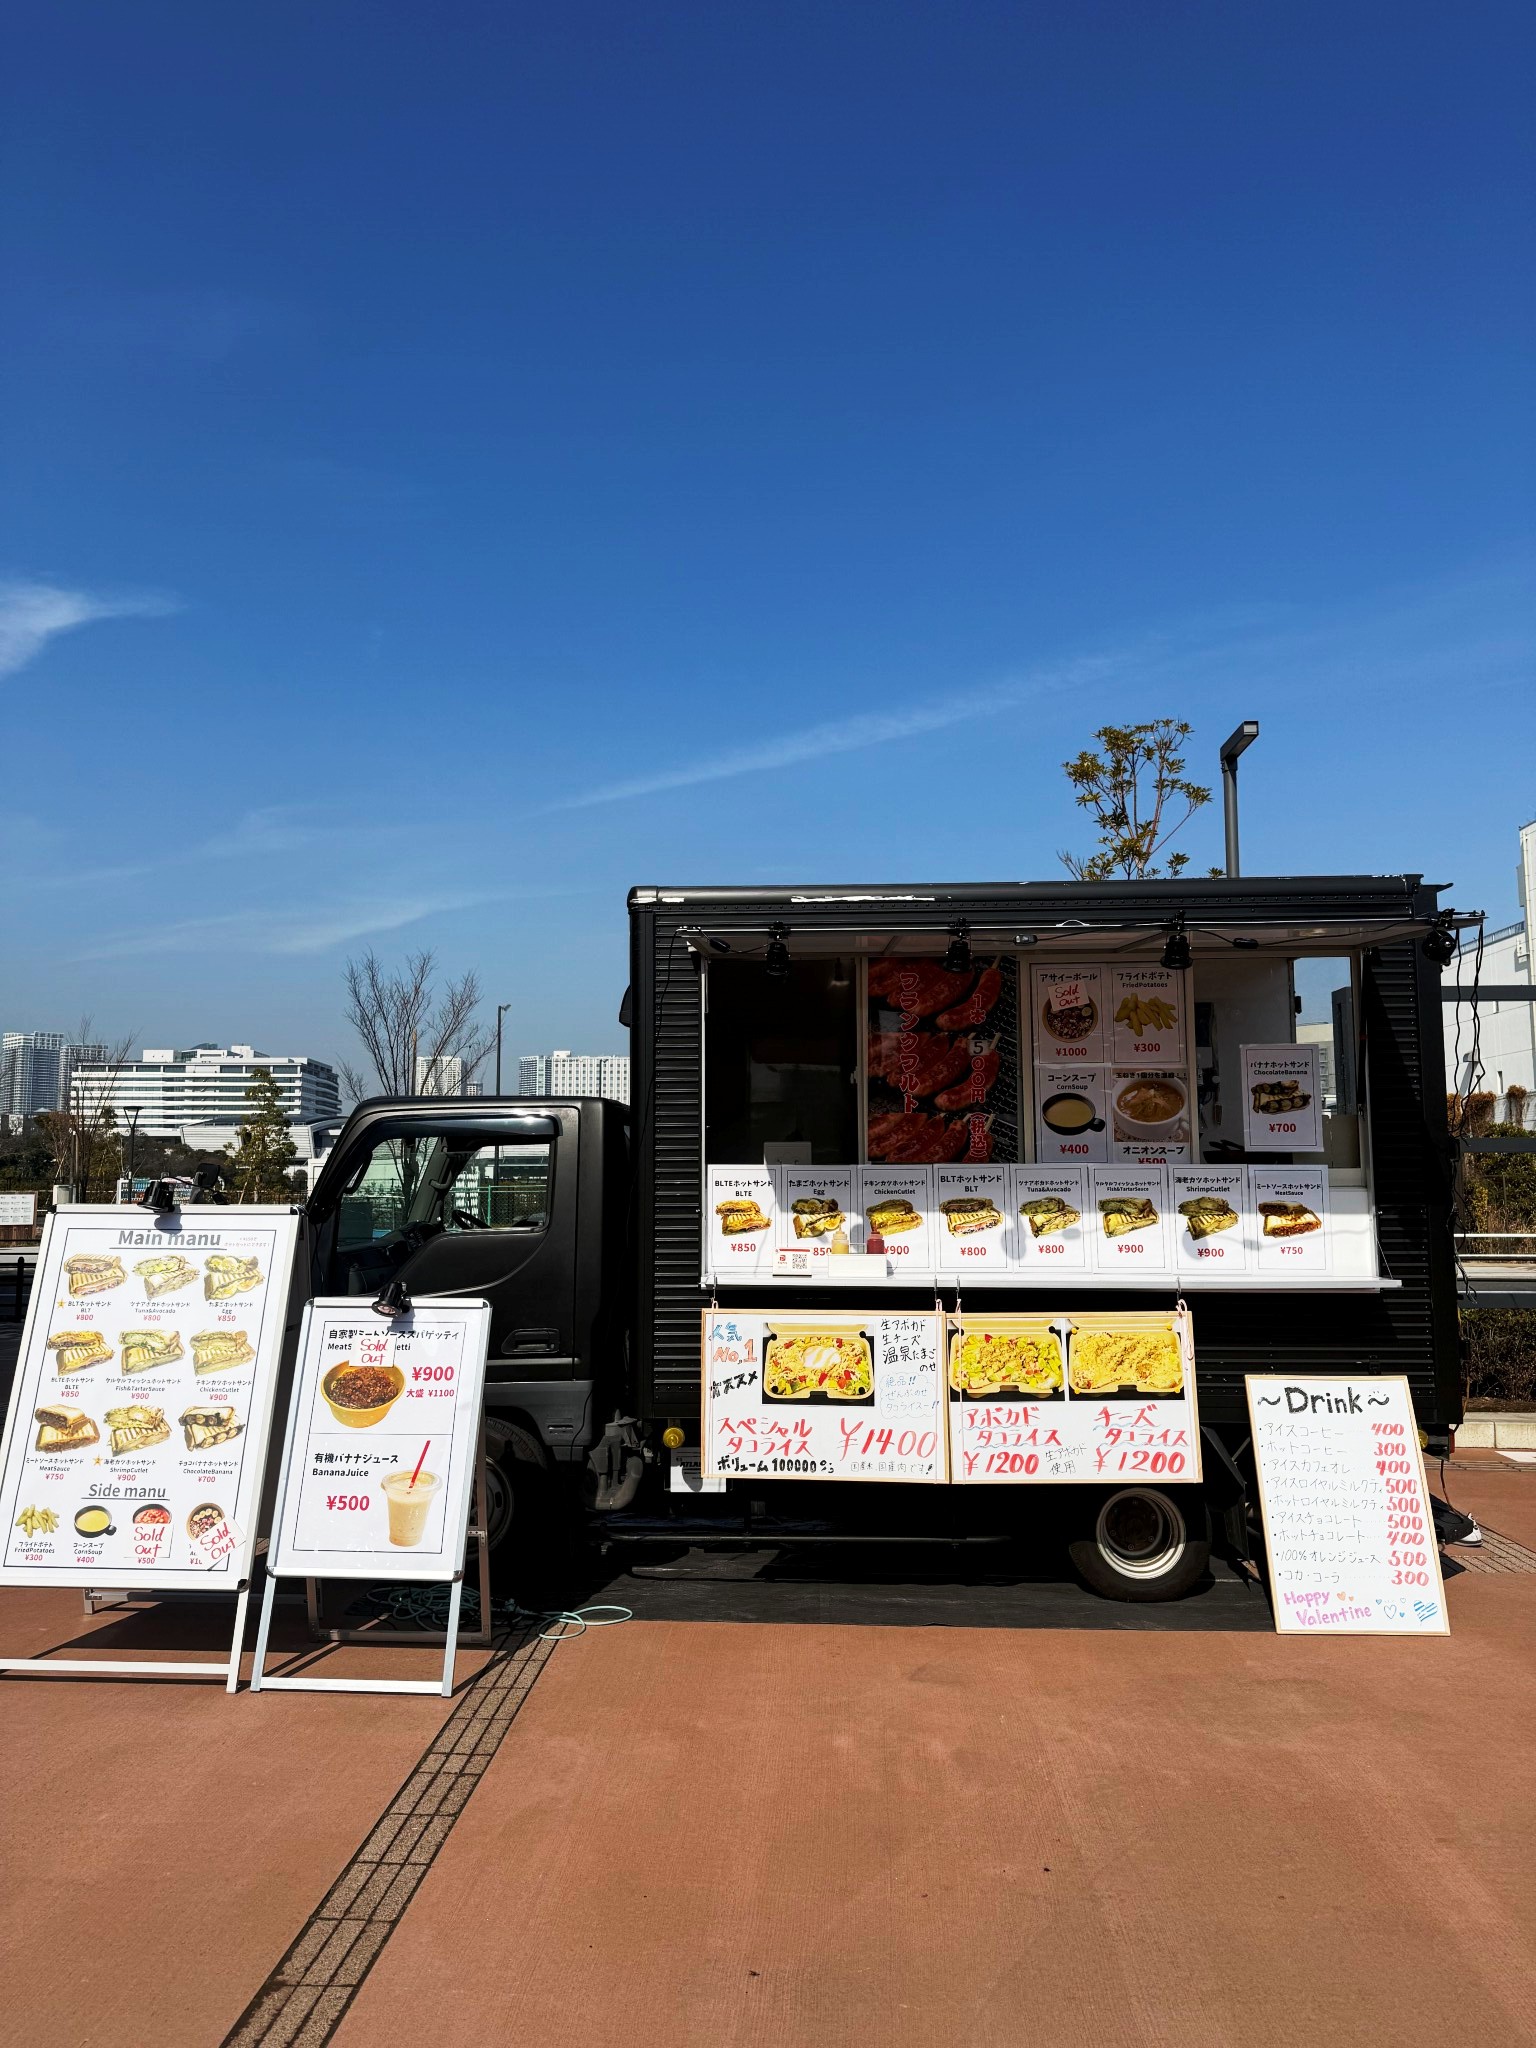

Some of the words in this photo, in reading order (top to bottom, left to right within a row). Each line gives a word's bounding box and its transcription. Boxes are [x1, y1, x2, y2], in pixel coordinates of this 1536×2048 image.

[1039, 972, 1098, 982] アサイーボール
[1116, 971, 1173, 981] フライドポテト
[1055, 983, 1079, 999] Sold
[1059, 996, 1080, 1007] Out
[899, 972, 920, 1114] フランクフルト
[1134, 1043, 1161, 1052] ¥300
[1055, 1047, 1087, 1056] ¥1000
[1047, 1073, 1096, 1082] コーンスープ
[1056, 1083, 1088, 1091] CornSoup
[1269, 1123, 1297, 1133] ¥700
[1059, 1144, 1089, 1154] ¥400
[1122, 1146, 1185, 1155] オニオンスープ
[940, 1175, 1002, 1183] BLTホットサンド
[1175, 1176, 1241, 1184] 海老カツホットサンド
[813, 1188, 825, 1196] Egg
[118, 1229, 162, 1245] Main
[167, 1233, 221, 1246] manu
[730, 1243, 757, 1252] ¥850
[813, 1247, 832, 1256] 850
[884, 1245, 910, 1255] ¥900
[960, 1247, 987, 1256] ¥800
[1037, 1244, 1065, 1254] ¥800
[1117, 1244, 1144, 1254] ¥900
[1197, 1248, 1225, 1258] ¥900
[1280, 1246, 1304, 1255] ¥750
[880, 1318, 927, 1332] 生アボカド
[712, 1321, 743, 1342] 人気
[359, 1338, 389, 1351] Sold
[882, 1333, 921, 1345] 生チーズ
[361, 1353, 386, 1366] Out
[882, 1345, 936, 1364] 温泉たまご
[919, 1362, 936, 1372] のせ
[411, 1366, 455, 1381] ¥900
[195, 1379, 253, 1387] チキンカツホットサンド
[60, 1390, 80, 1398] ¥850
[130, 1392, 150, 1400] ¥900
[209, 1393, 228, 1401] ¥900
[406, 1388, 423, 1398] 大盛
[428, 1389, 455, 1397] ¥1100
[961, 1406, 1040, 1428] アボカド
[1093, 1403, 1158, 1427] チーズ
[717, 1417, 813, 1438] スペシャル
[1264, 1422, 1344, 1439] アイスコーヒー
[1370, 1423, 1405, 1436] 400
[838, 1417, 938, 1461] ¥1400
[976, 1428, 1063, 1446] タコライス
[1104, 1427, 1189, 1446] タコライス
[726, 1437, 814, 1457] タコライス
[1267, 1440, 1348, 1455] ホットコーヒー
[1373, 1442, 1407, 1456] 300
[25, 1457, 84, 1465] ミートソースホットサンド
[314, 1453, 399, 1464] 有機バナナジュース
[963, 1450, 1040, 1476] ¥1200
[1093, 1446, 1186, 1474] ¥1200
[109, 1467, 148, 1475] ShrimpCutlet
[312, 1468, 369, 1477] BananaJuice
[1269, 1459, 1351, 1474] アイスカフェオレ
[1375, 1460, 1411, 1476] 400
[117, 1473, 137, 1482] ¥900
[197, 1475, 216, 1483] ¥700
[88, 1483, 121, 1497] Side
[124, 1487, 167, 1498] manu
[1385, 1478, 1417, 1494] 500
[326, 1495, 370, 1511] ¥500
[1386, 1496, 1420, 1514] 500
[1275, 1511, 1362, 1528] アイスチョコレート
[1387, 1514, 1423, 1530] 500
[133, 1526, 165, 1541] Sold
[199, 1521, 231, 1551] Sold
[1279, 1529, 1365, 1544] ホットチョコレート
[1386, 1531, 1425, 1546] 400
[14, 1546, 55, 1554] FriedPotatoes
[73, 1548, 103, 1556] CornSoup
[134, 1543, 162, 1557] Out
[211, 1536, 236, 1560] Out
[24, 1553, 43, 1561] ¥300
[76, 1555, 95, 1564] ¥400
[137, 1557, 155, 1565] ¥500
[1388, 1550, 1428, 1567] 500
[1391, 1570, 1430, 1586] 300
[1283, 1591, 1330, 1607] Happy
[1295, 1605, 1372, 1626] Valentine
